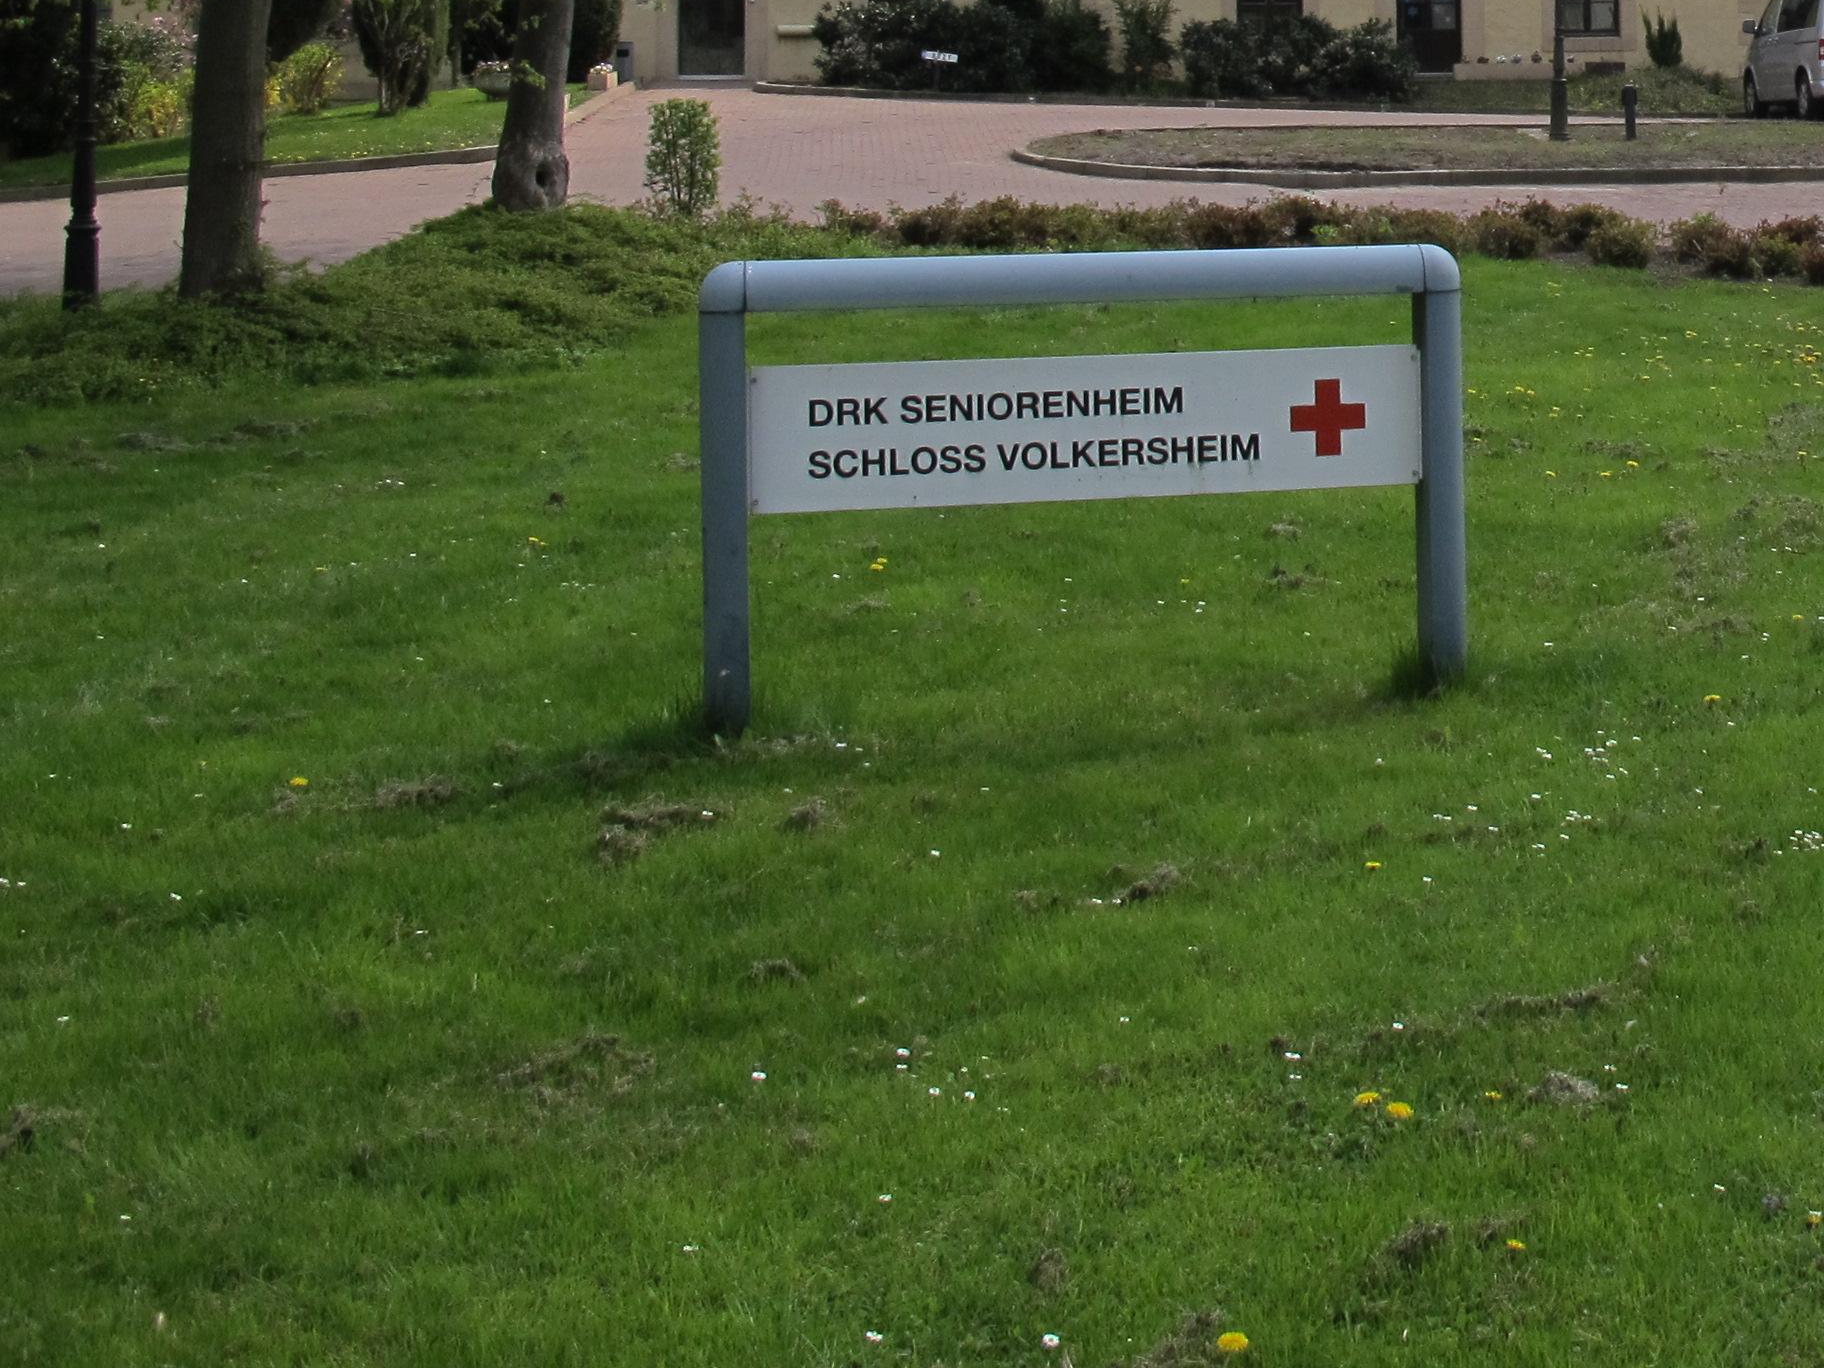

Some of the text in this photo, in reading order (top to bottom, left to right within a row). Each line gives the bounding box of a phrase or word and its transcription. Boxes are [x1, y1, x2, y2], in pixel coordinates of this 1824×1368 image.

[808, 386, 1183, 427] DRK SENIORENHEIM
[808, 433, 1260, 480] SCHLOSS VOLKERSHEIM
